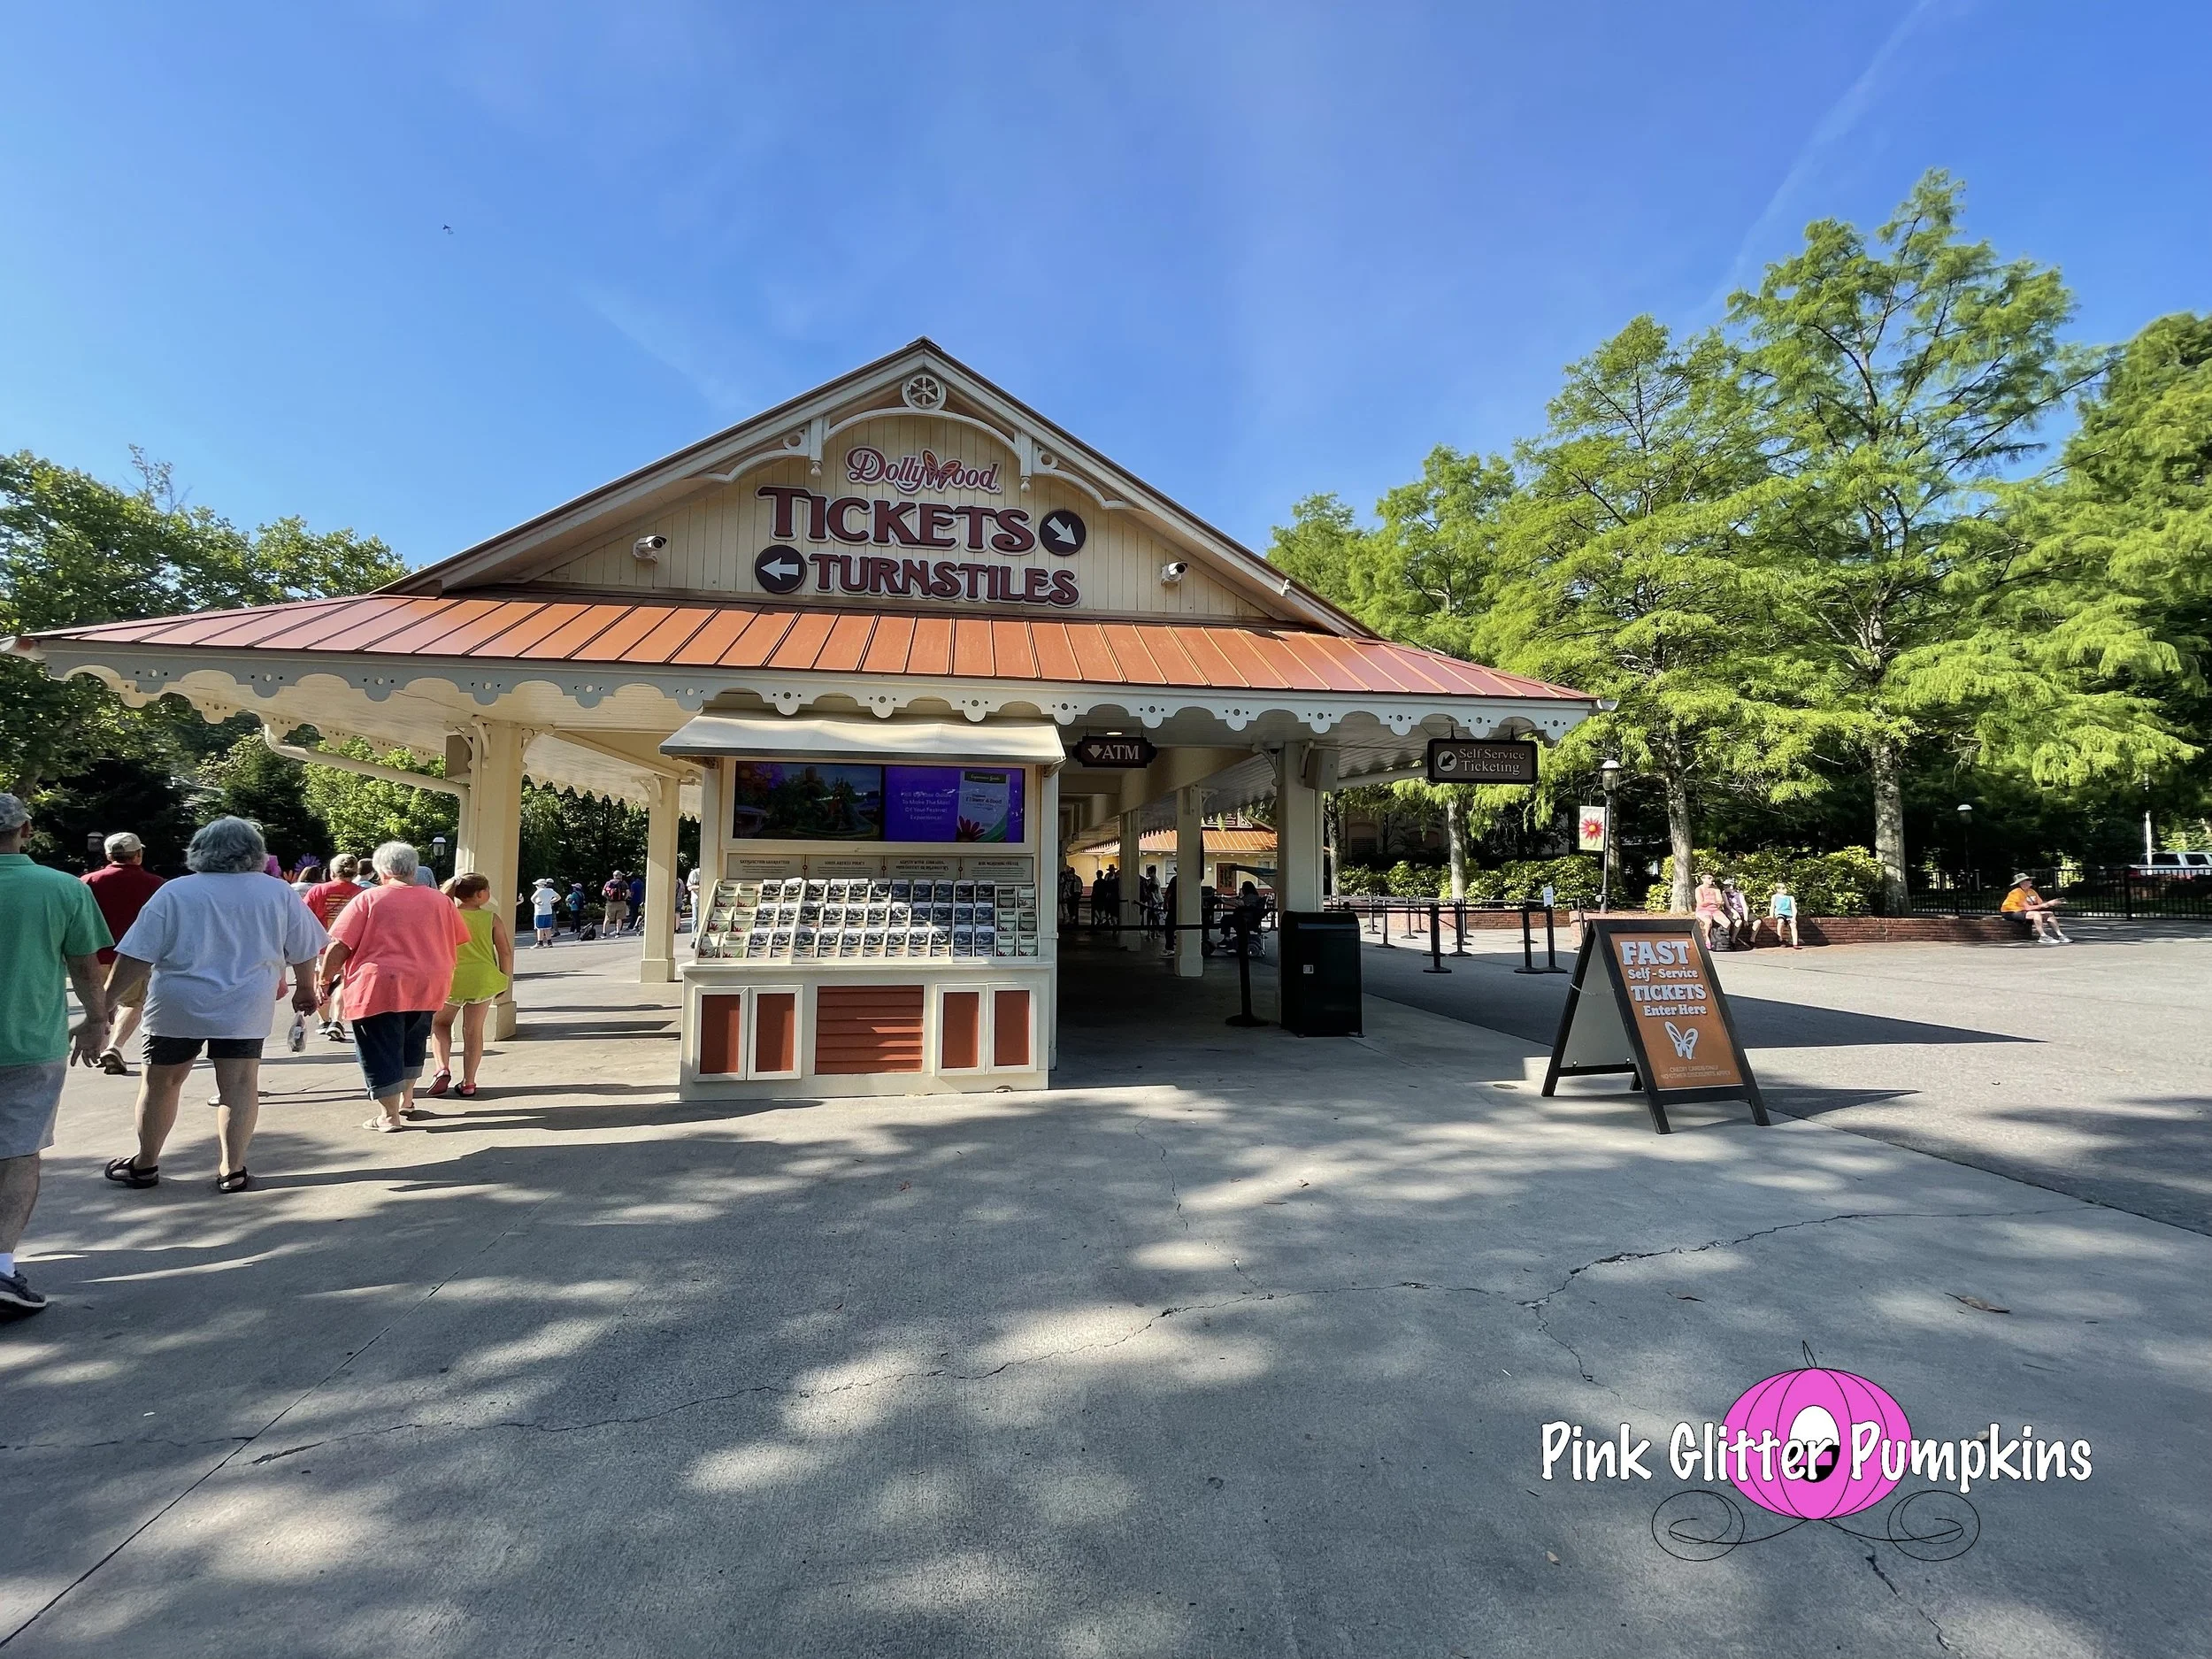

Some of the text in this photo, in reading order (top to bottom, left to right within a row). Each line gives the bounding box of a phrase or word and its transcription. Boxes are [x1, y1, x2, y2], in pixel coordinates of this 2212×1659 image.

[757, 486, 1036, 553] TICKETS
[809, 552, 1080, 606] TURNSTILES
[1102, 744, 1140, 760] ATM
[1459, 748, 1525, 759] Self Service
[1461, 760, 1520, 775] Ticketing
[1620, 941, 1689, 966] FAST
[1628, 969, 1650, 981] Self
[1658, 967, 1698, 979] Service
[1631, 984, 1707, 1002] TICKETS
[1643, 1004, 1707, 1017] Enter Here
